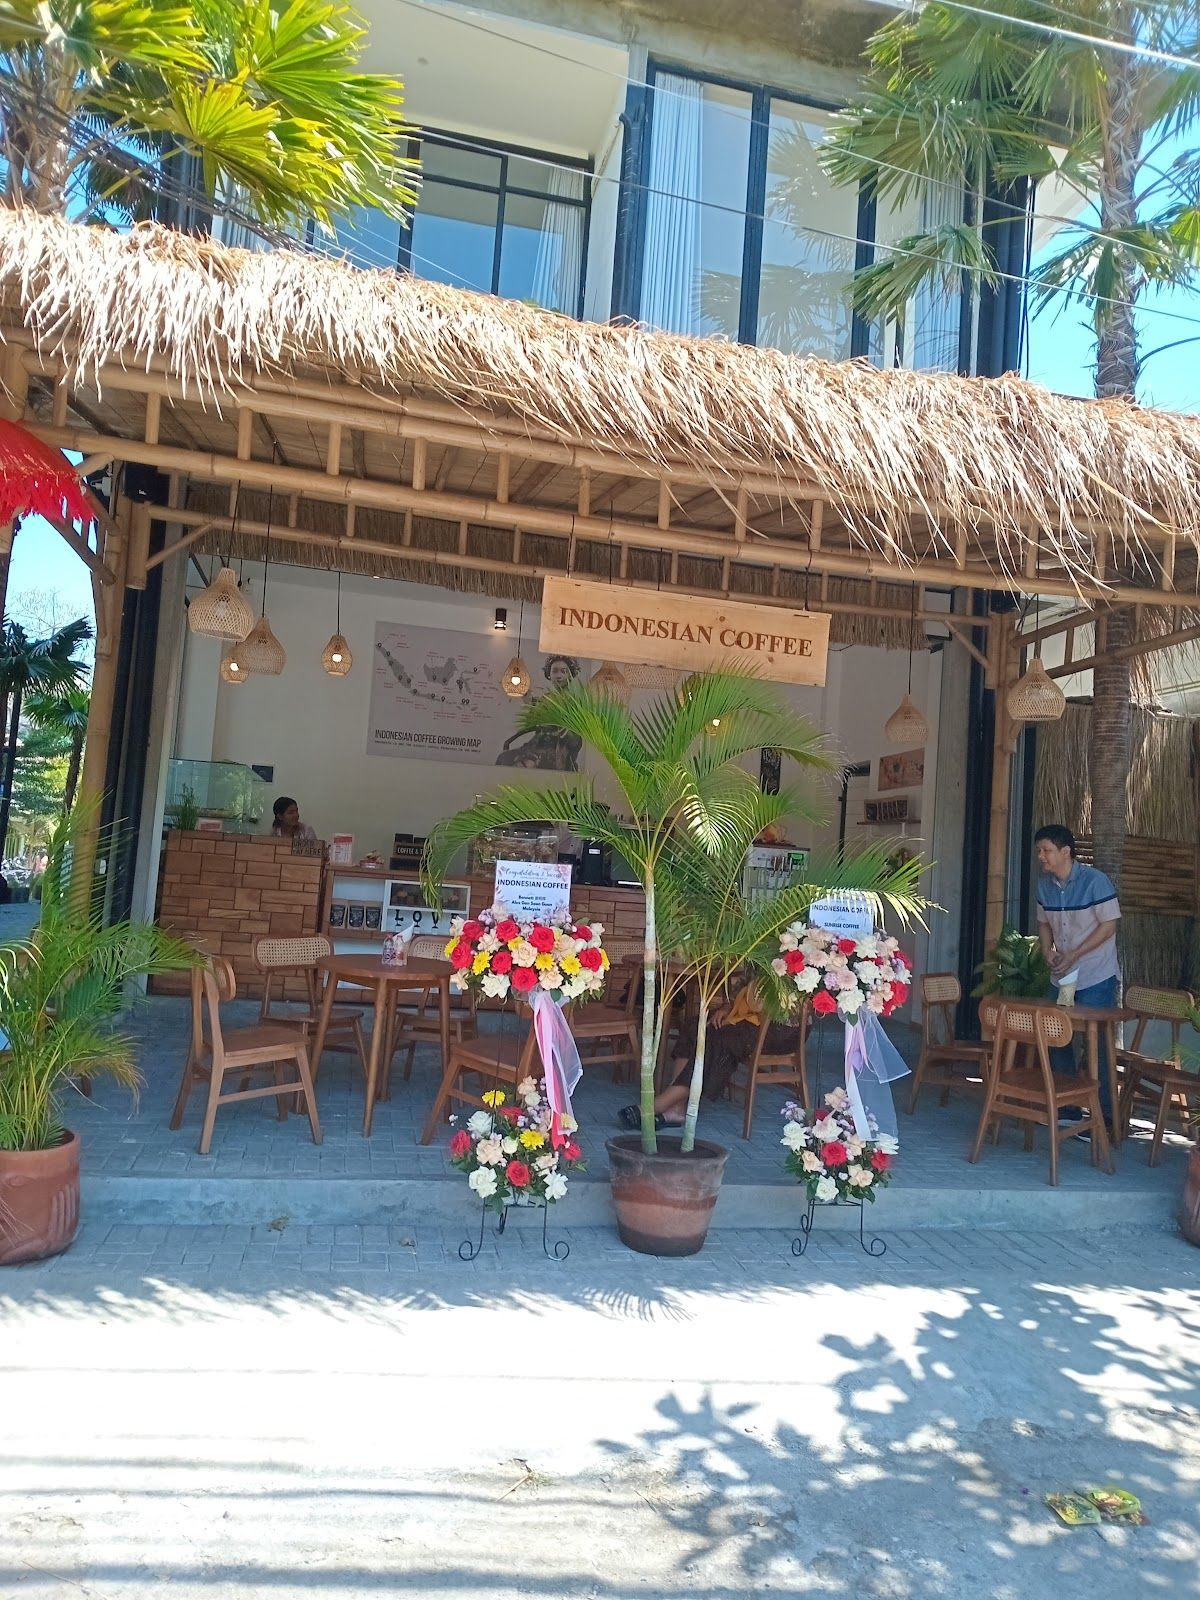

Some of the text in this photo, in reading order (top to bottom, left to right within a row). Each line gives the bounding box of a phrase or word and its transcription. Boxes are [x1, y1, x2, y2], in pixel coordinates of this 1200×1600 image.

[559, 606, 814, 658] INDONESIAN COFFEE
[375, 729, 413, 742] INDONESIAN
[413, 733, 437, 745] COFFEE
[437, 735, 466, 747] GROWING
[466, 738, 482, 748] MAP
[397, 847, 414, 855] COFFEE
[498, 880, 541, 888] INDONESIAN
[812, 904, 850, 913] INDONESIAN
